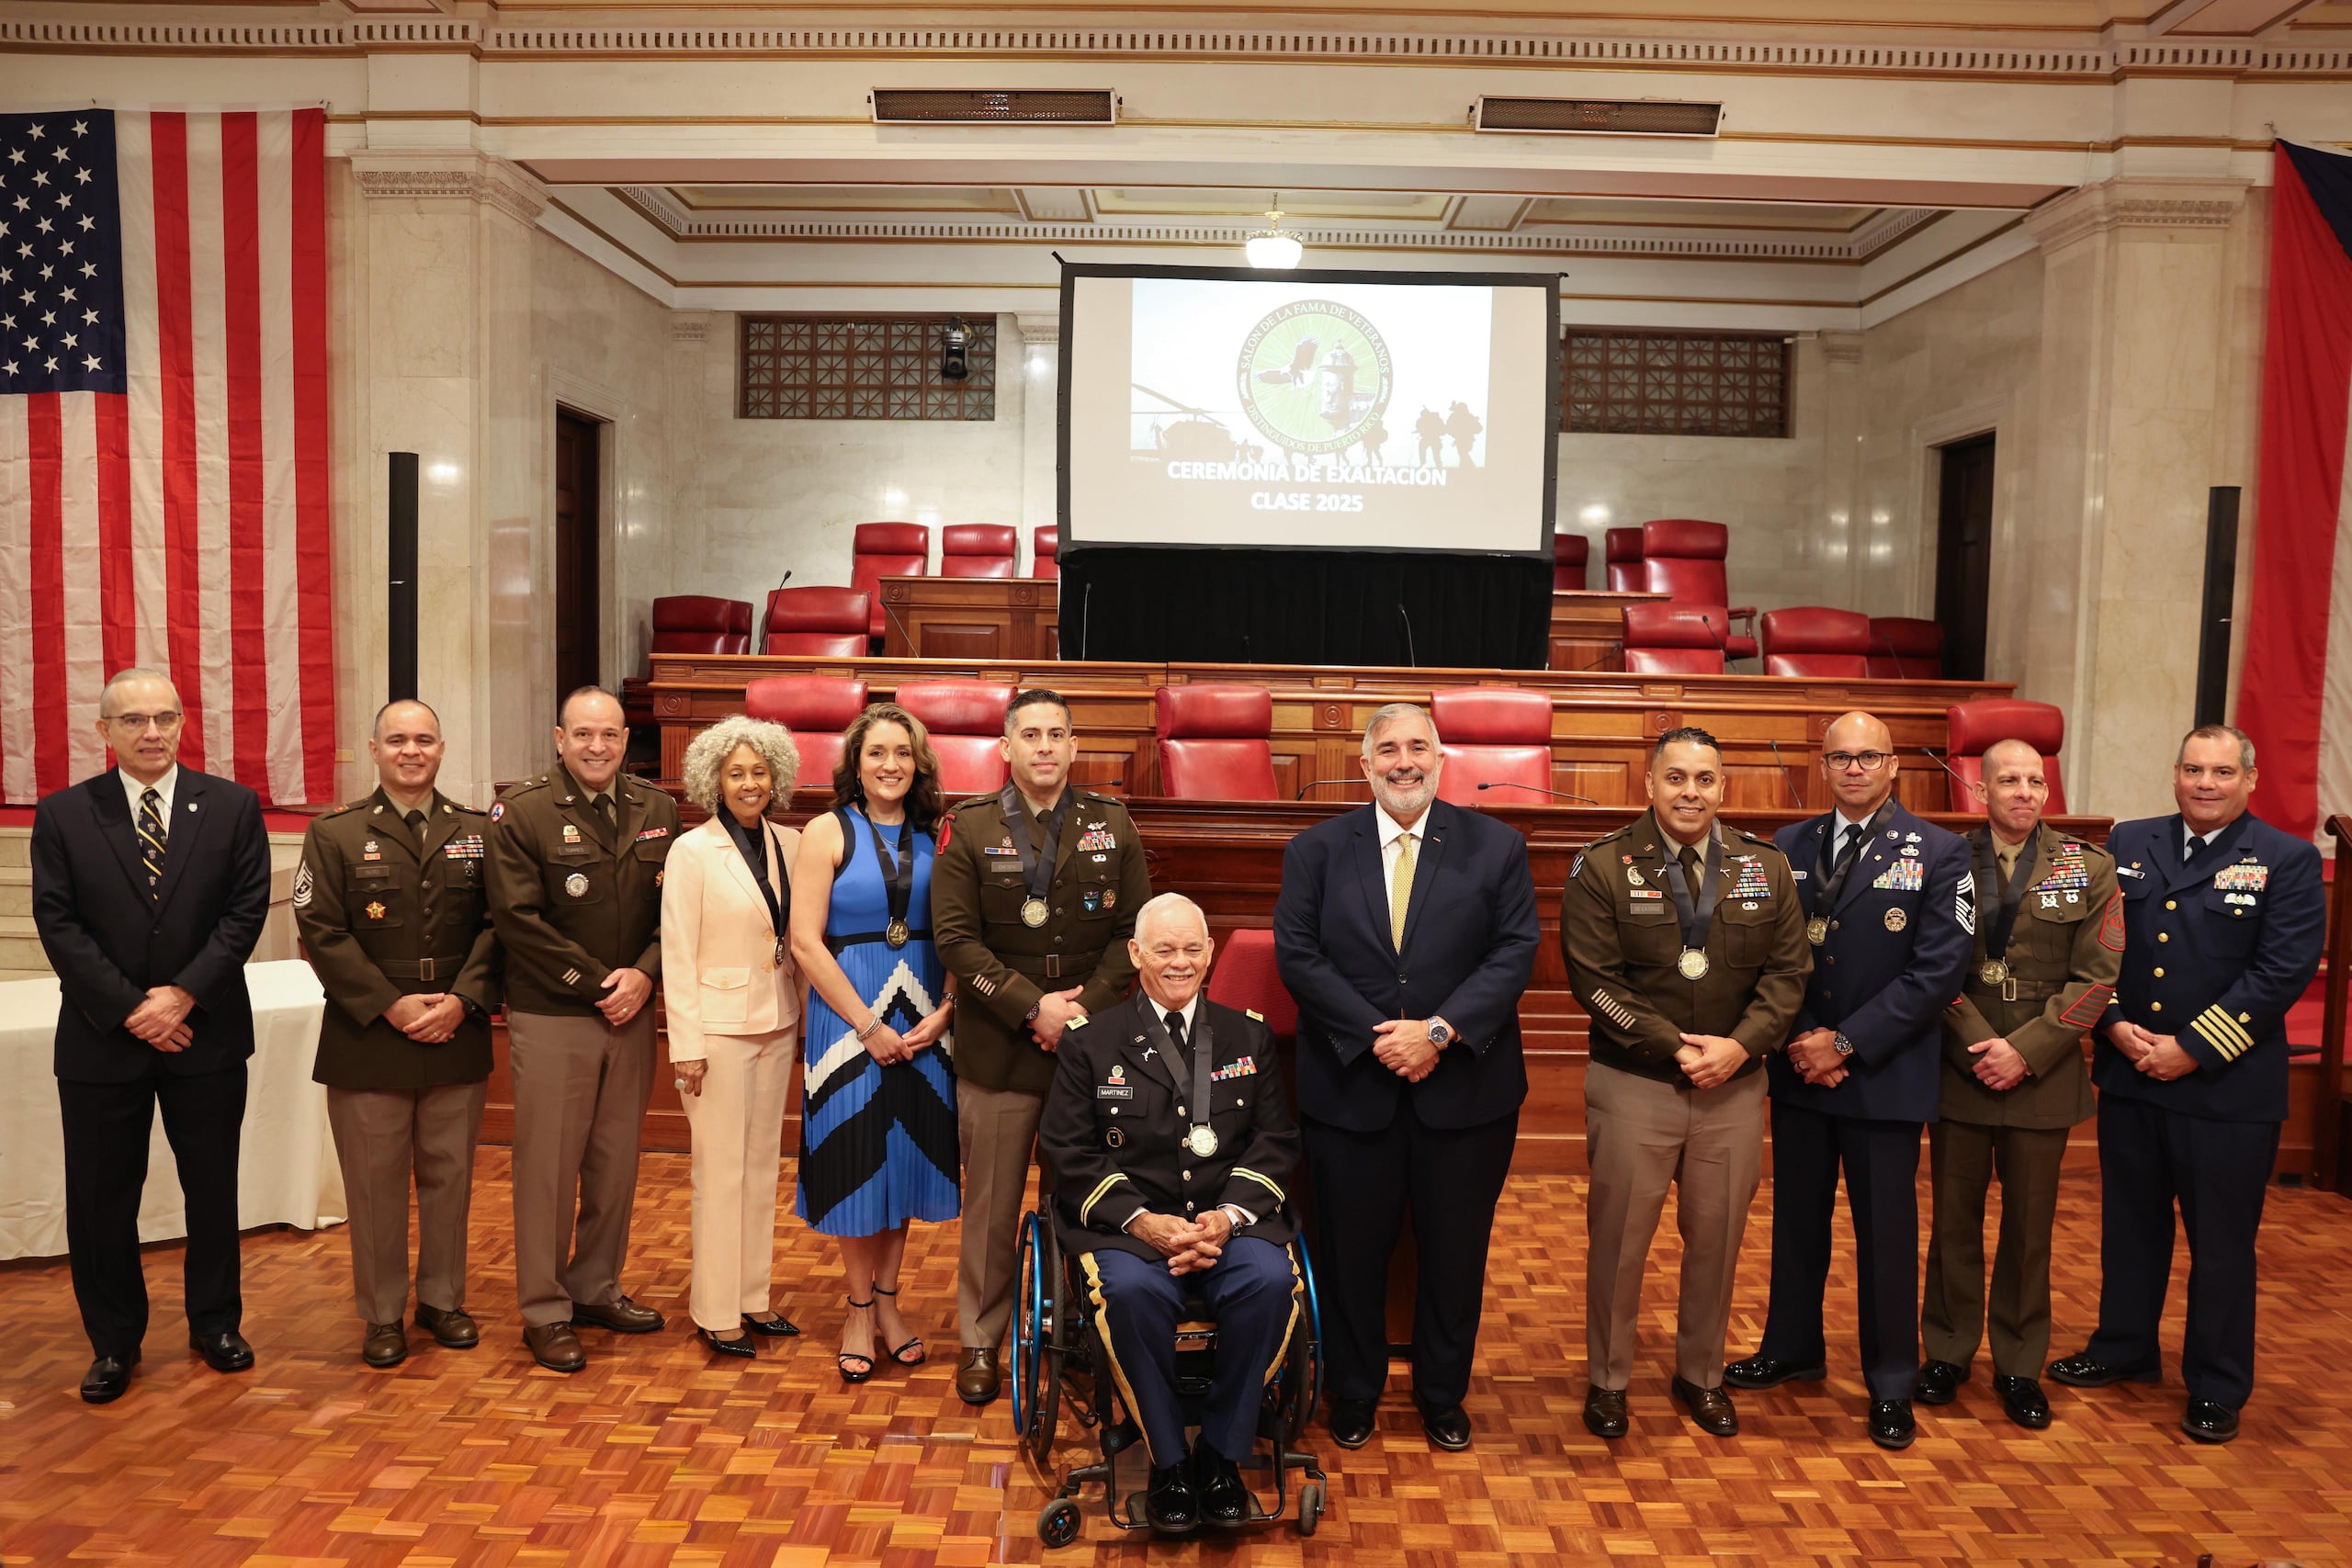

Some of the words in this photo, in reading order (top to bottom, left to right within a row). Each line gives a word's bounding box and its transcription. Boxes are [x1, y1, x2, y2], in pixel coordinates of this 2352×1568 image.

[1240, 329, 1262, 369] SALON
[1261, 317, 1277, 332] DE
[1275, 308, 1293, 321] LA
[1293, 302, 1327, 315] FAMA
[1329, 304, 1346, 317] DE
[1349, 311, 1390, 375] VETERANOS
[1247, 403, 1306, 451] DISTINGUIDOS
[1307, 443, 1322, 452] DE
[1323, 431, 1362, 451] PUERTO
[1359, 412, 1380, 434] RICO
[1167, 461, 1290, 482] CEREMONIA
[1295, 465, 1321, 482] DE
[1326, 463, 1447, 486] EXALTACIÓN
[1250, 491, 1311, 511] CLASE
[1315, 493, 1363, 513] 2025
[1101, 1089, 1129, 1097] MARTINEZ
